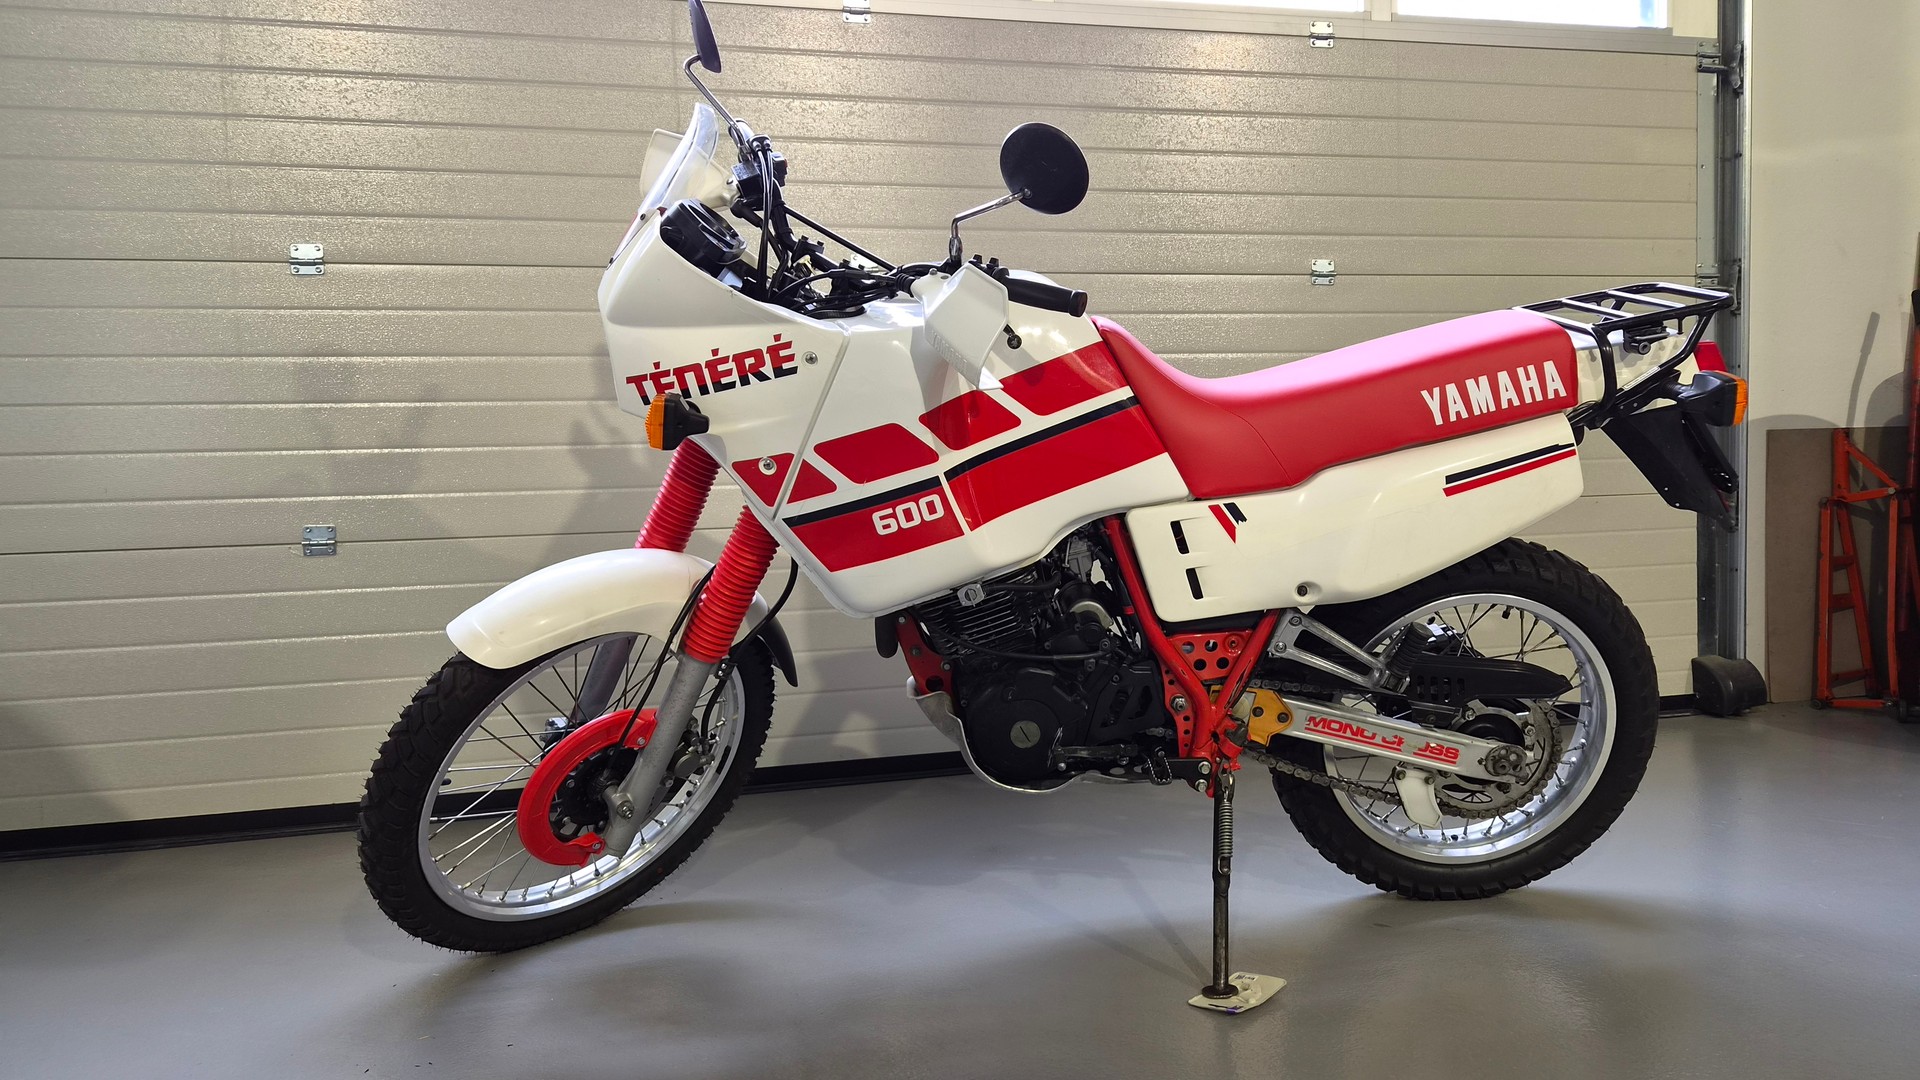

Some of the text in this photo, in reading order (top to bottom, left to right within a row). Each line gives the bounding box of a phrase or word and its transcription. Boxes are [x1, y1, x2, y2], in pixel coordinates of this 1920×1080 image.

[626, 334, 799, 406] TÉNÉRÉ
[1420, 359, 1567, 426] YAMAHA
[871, 493, 945, 536] 600
